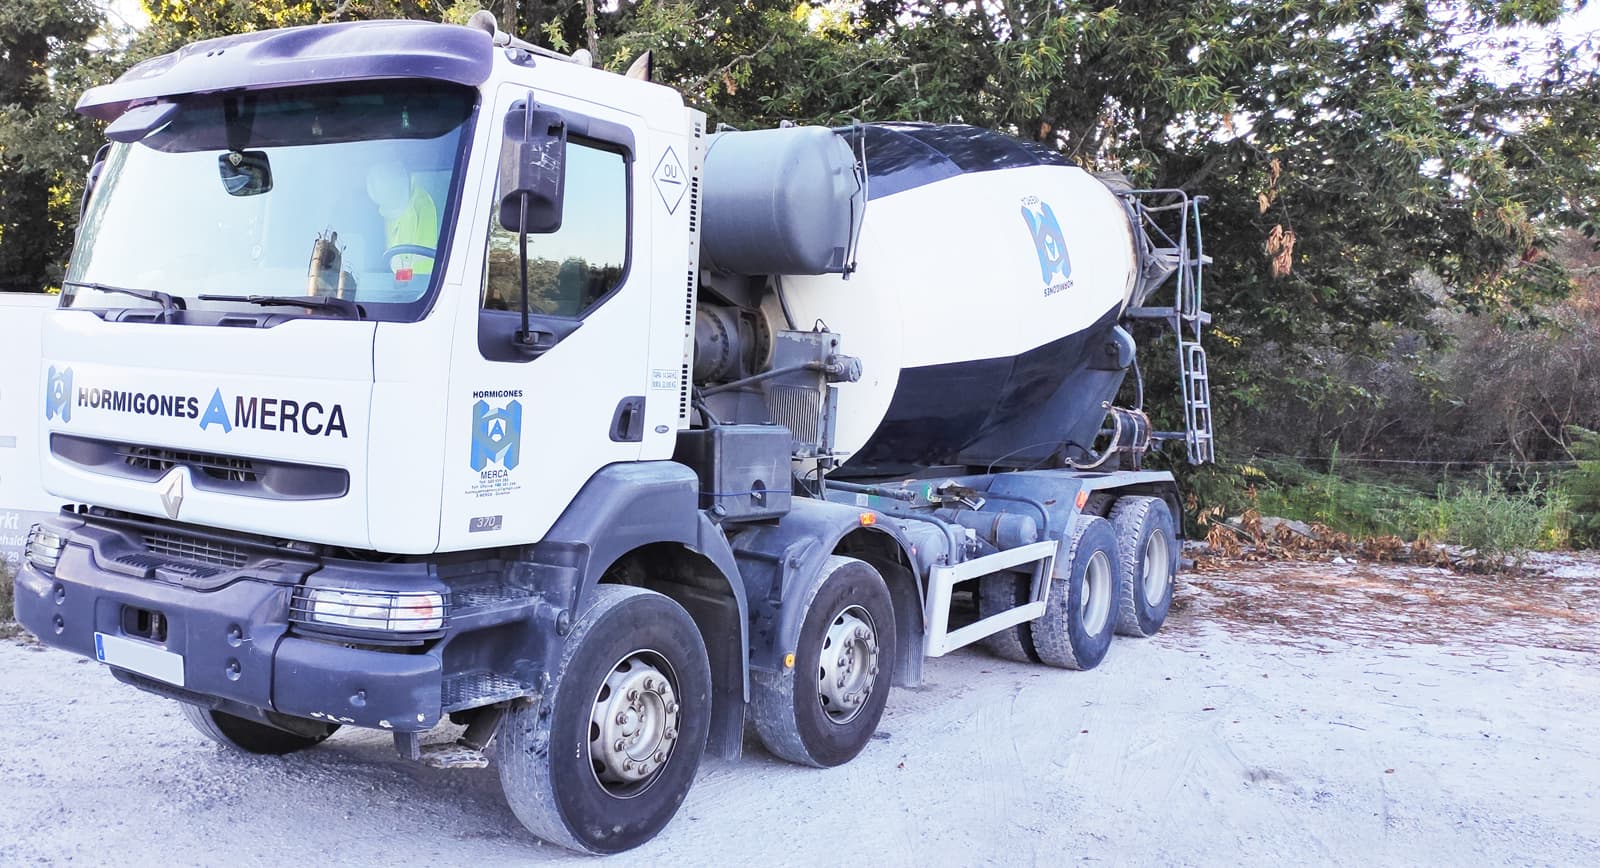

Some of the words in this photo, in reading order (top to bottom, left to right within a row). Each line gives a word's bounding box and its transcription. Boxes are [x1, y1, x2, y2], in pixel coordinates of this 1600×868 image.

[473, 390, 523, 398] HORMIGONES
[78, 386, 199, 419] HORMIGONES
[199, 387, 232, 434] A
[234, 395, 348, 438] MERCA
[480, 469, 508, 479] MERCA
[476, 516, 496, 528] 370
